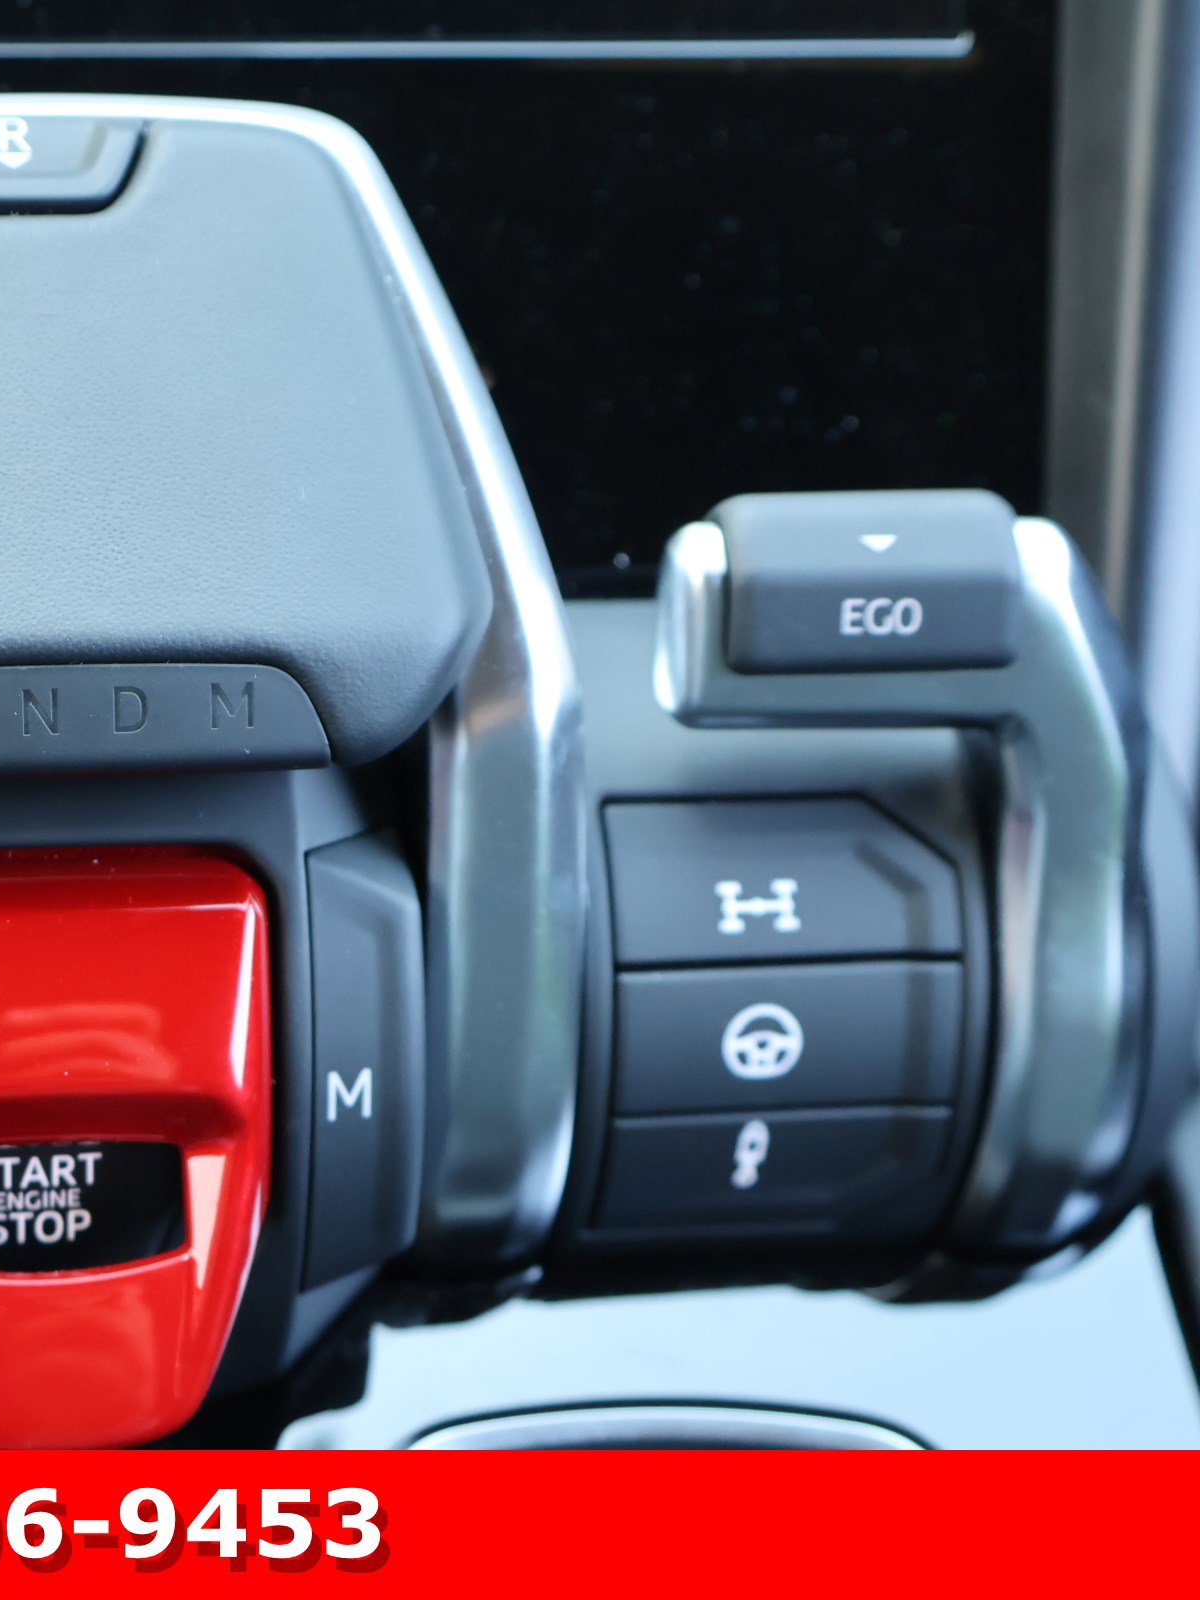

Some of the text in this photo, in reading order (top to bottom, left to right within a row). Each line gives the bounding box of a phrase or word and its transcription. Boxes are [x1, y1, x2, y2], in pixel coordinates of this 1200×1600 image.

[840, 597, 923, 636] EGO
[22, 687, 60, 736] N
[113, 686, 149, 733] D
[211, 681, 255, 730] M
[327, 1067, 372, 1122] M
